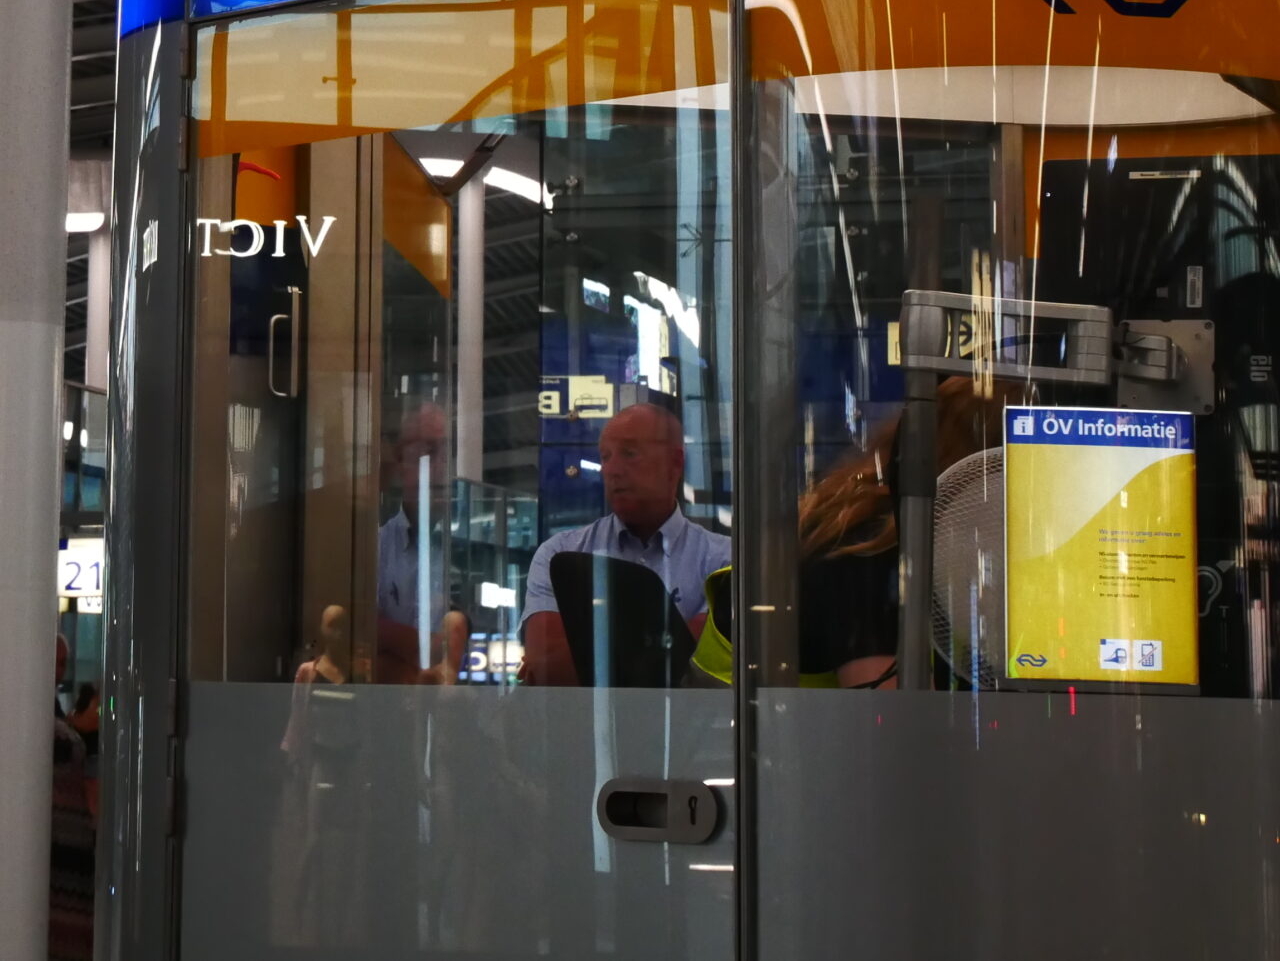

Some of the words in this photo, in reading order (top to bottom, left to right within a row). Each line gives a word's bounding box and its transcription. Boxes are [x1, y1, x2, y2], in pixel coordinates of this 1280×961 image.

[1042, 418, 1074, 436] OV
[1077, 418, 1177, 439] Informatie
[64, 561, 101, 591] 21
